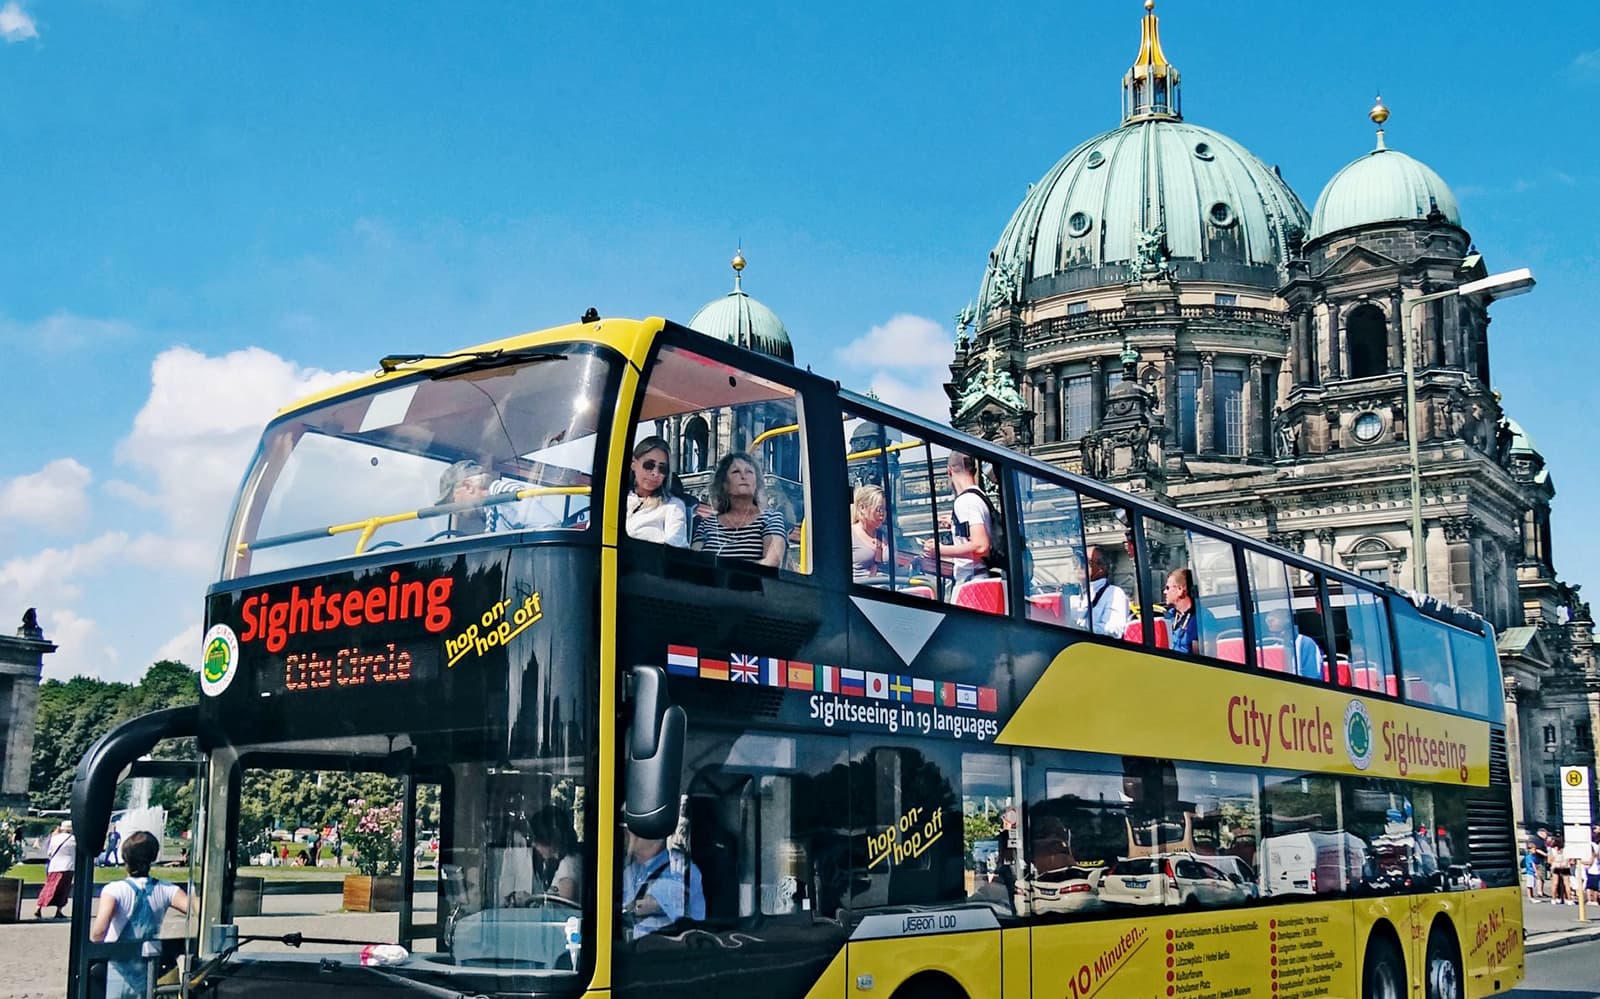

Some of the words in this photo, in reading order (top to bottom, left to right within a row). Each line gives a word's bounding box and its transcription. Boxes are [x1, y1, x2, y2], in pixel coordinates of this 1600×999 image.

[241, 571, 454, 654] Sightseeing
[445, 622, 478, 660] hop
[481, 597, 512, 627] on-
[474, 621, 511, 657] hop
[513, 591, 542, 626] off
[285, 651, 332, 691] City
[336, 643, 412, 685] Circle
[809, 694, 898, 733] Sightseeing
[900, 704, 915, 728] in
[916, 711, 931, 735] 19
[933, 706, 998, 741] languages
[1228, 695, 1272, 764] City
[1278, 702, 1334, 756] Circle
[1382, 719, 1468, 783] Sightseeing
[867, 825, 896, 861] hop
[899, 806, 924, 833] on-
[893, 831, 921, 866] hop
[924, 806, 944, 839] off
[939, 914, 957, 930] LDD
[1068, 964, 1092, 999] 10
